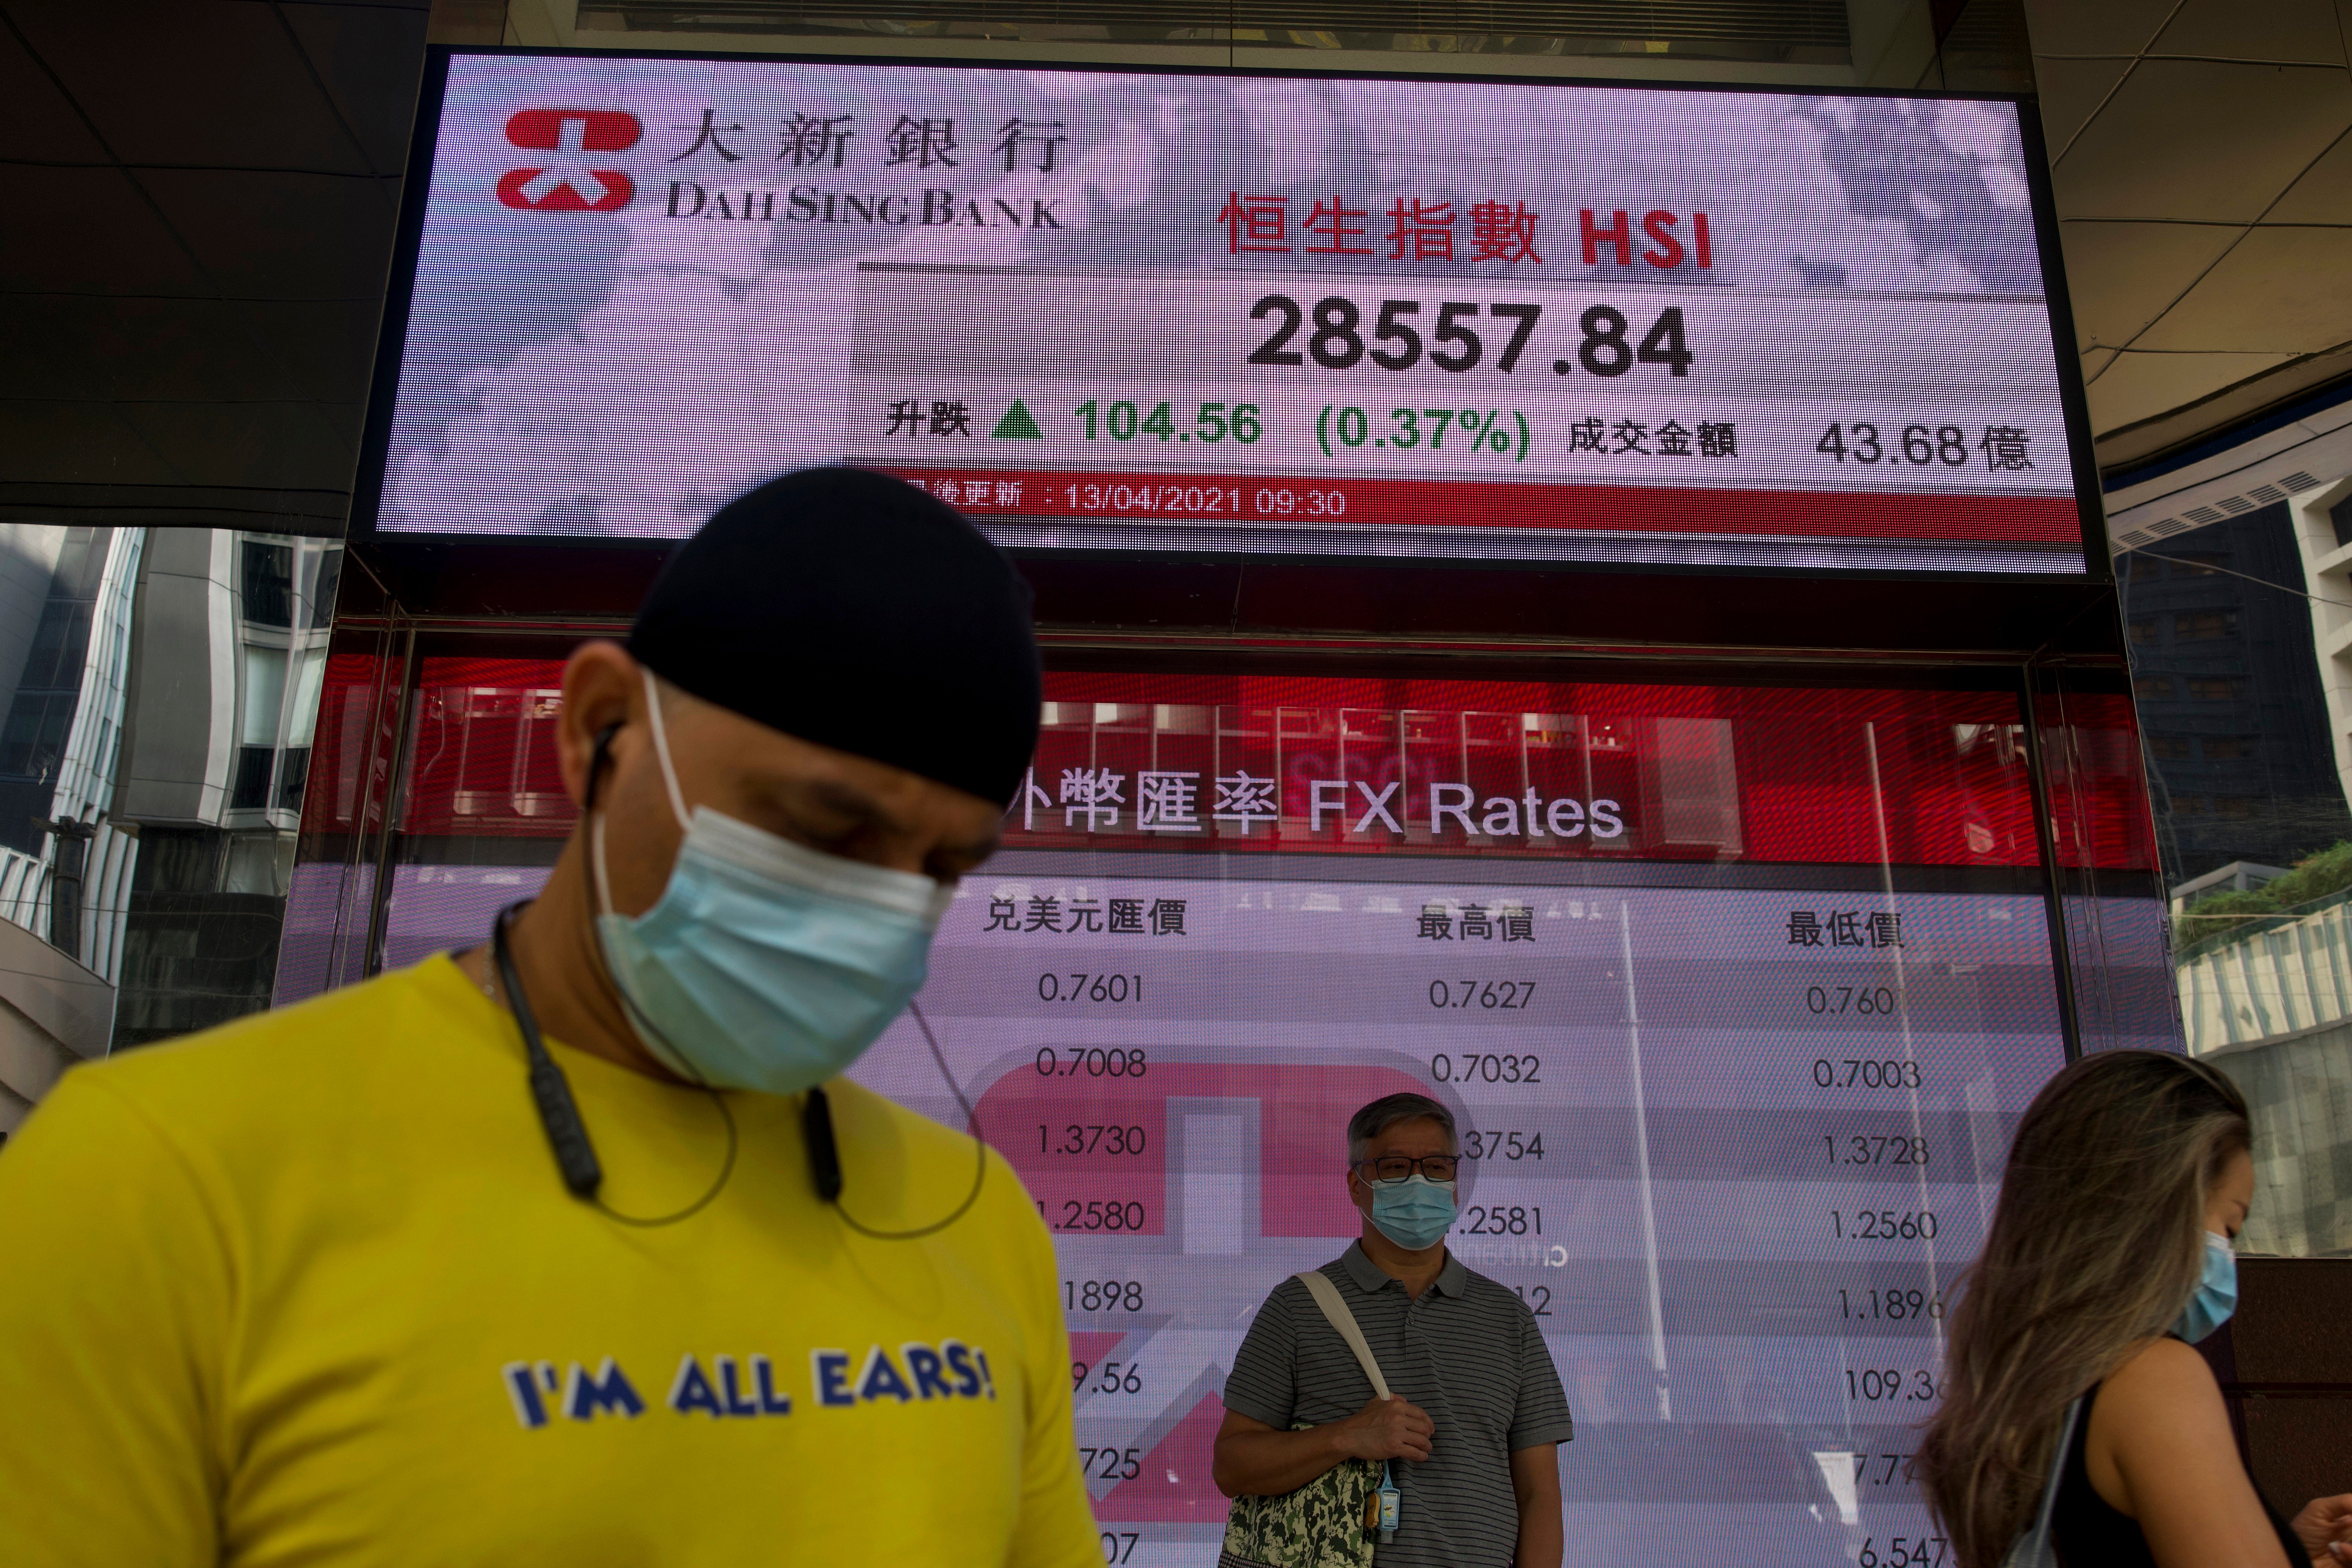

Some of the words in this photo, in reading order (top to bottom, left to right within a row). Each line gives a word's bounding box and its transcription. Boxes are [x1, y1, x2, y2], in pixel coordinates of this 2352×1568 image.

[670, 108, 1067, 174] 大新銀行
[1217, 190, 1545, 266] 恒生指數
[1579, 208, 1713, 270] HSI
[1247, 293, 1695, 378] 28557.84
[886, 400, 970, 438] 升跌
[1073, 398, 1263, 445] 104.56
[1316, 405, 1530, 463] (0.37%)
[1568, 418, 1738, 460] 成交金額
[1815, 422, 1968, 469] 43.68
[1980, 423, 2033, 472] 億
[1064, 484, 1241, 514] 13/04/2021
[1255, 488, 1346, 516] 09:30
[1309, 779, 1404, 835] FX
[1430, 782, 1625, 839] Rates
[1416, 902, 1537, 942] 最高價
[1786, 910, 1905, 948] 最低價
[1037, 972, 1144, 1003] 0.7601
[1428, 979, 1536, 1010] 0.7627
[1036, 1047, 1147, 1078] 0.7008
[1432, 1054, 1541, 1083] 0.7032
[1813, 1059, 1921, 1089] 0.7003
[1038, 1125, 1145, 1155] 1.3730
[1824, 1135, 1929, 1165] 1.3728
[1036, 1200, 1144, 1231] 1.2580
[1447, 1205, 1542, 1235] .2581
[1831, 1211, 1937, 1239] 1.2560
[1838, 1289, 1946, 1320] 1.1896
[502, 1354, 646, 1429] I'M
[668, 1352, 792, 1419] ALL
[810, 1338, 996, 1406] EARS!
